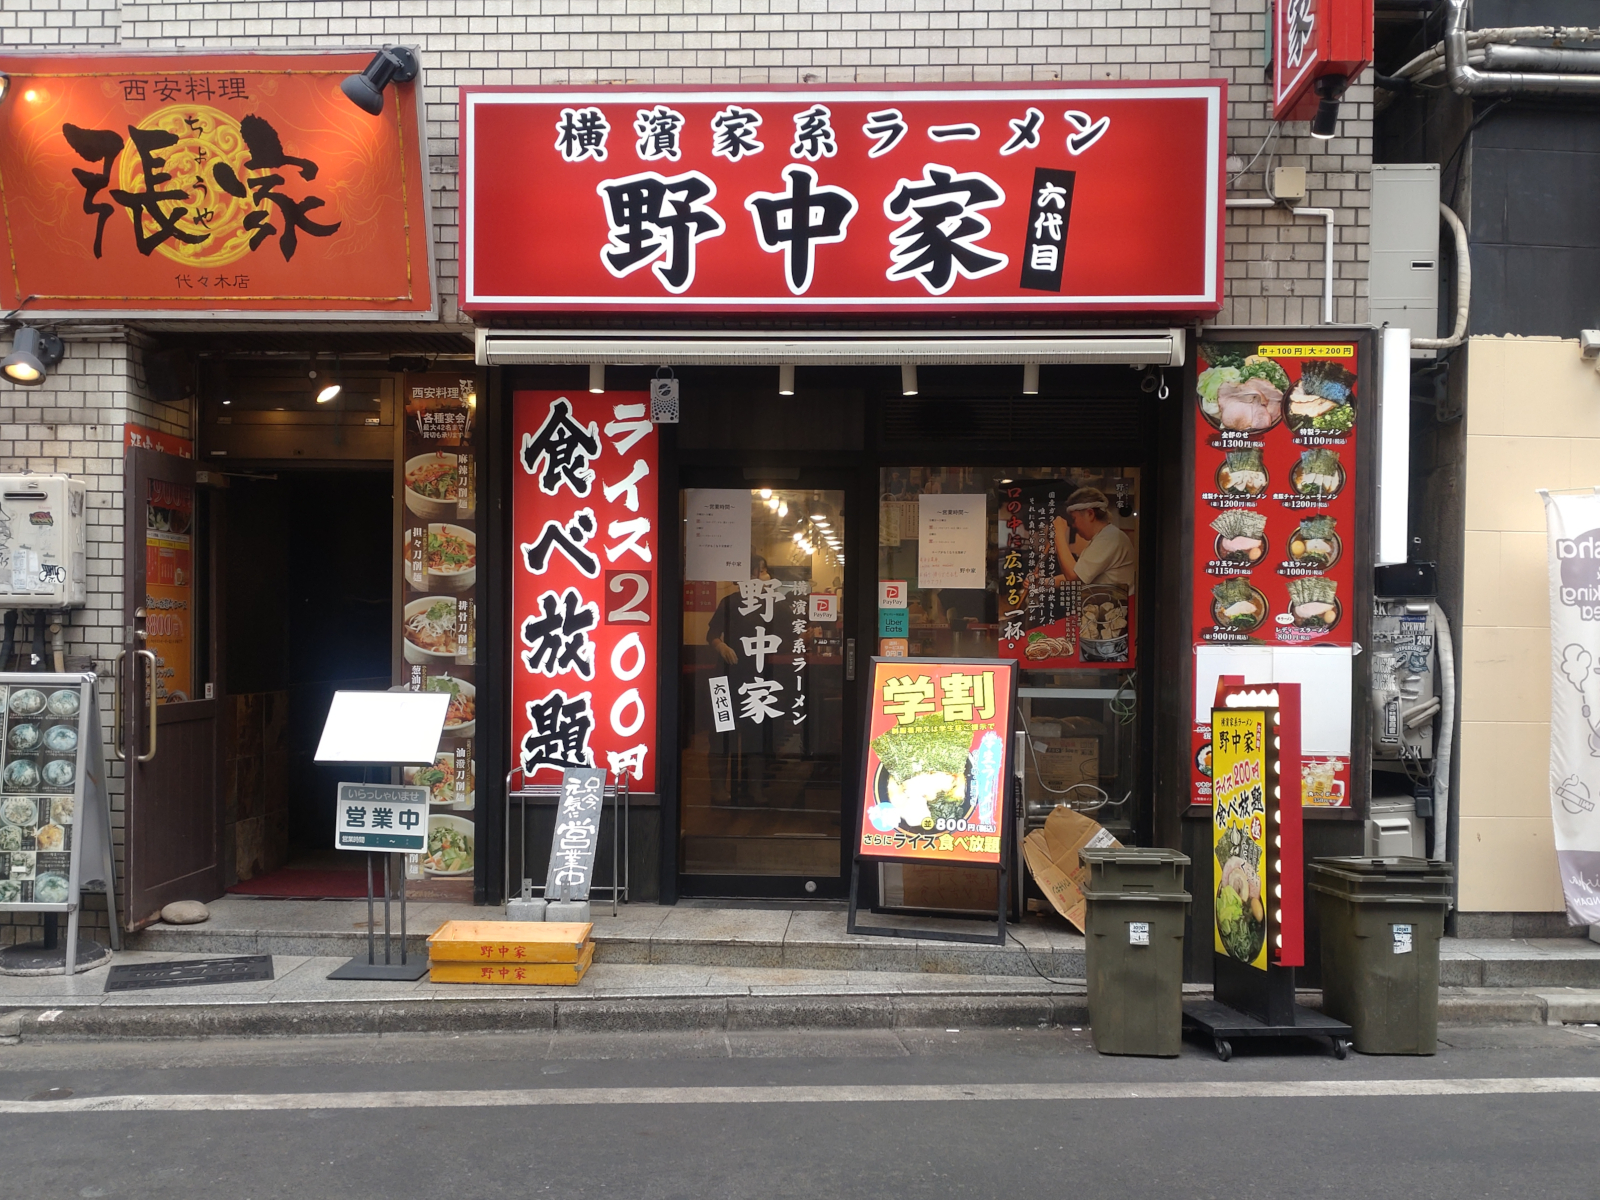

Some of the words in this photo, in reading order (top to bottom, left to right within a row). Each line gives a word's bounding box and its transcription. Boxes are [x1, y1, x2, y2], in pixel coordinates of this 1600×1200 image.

[119, 77, 249, 101] 西安料理
[555, 105, 1111, 161] 横濱家系ラーメン
[62, 113, 342, 263] 張家
[184, 115, 215, 229] ちょうや
[597, 164, 1009, 296] 野中家
[1030, 181, 1066, 273] 六代目
[174, 273, 250, 289] 代々木店
[412, 387, 459, 399] 西安料理
[423, 412, 466, 423] 各種宴会
[1300, 428, 1342, 436] 特製ラーメン
[520, 396, 602, 778] 食べ放題
[1004, 487, 1026, 650] 口の中に広がる一杯。
[602, 403, 654, 781] ライス200円
[738, 578, 786, 724] 野中家
[791, 581, 808, 726] 横濱家系ラーメン
[1417, 635, 1431, 645] 24K
[713, 684, 731, 723] 六代目
[882, 671, 996, 725] 学割
[1218, 729, 1255, 754] 野中家
[348, 789, 420, 802] いらっしゃいませ
[1215, 760, 1261, 796] ライス200円
[563, 777, 587, 819] 元気に
[1214, 784, 1264, 828] 食べ放題
[346, 806, 420, 830] 営業中
[342, 835, 366, 844] 営業時間
[554, 817, 596, 886] 営業中
[863, 834, 1001, 853] さらにライス食べ放題
[480, 945, 527, 958] 野中家
[480, 967, 527, 980] 野中家
